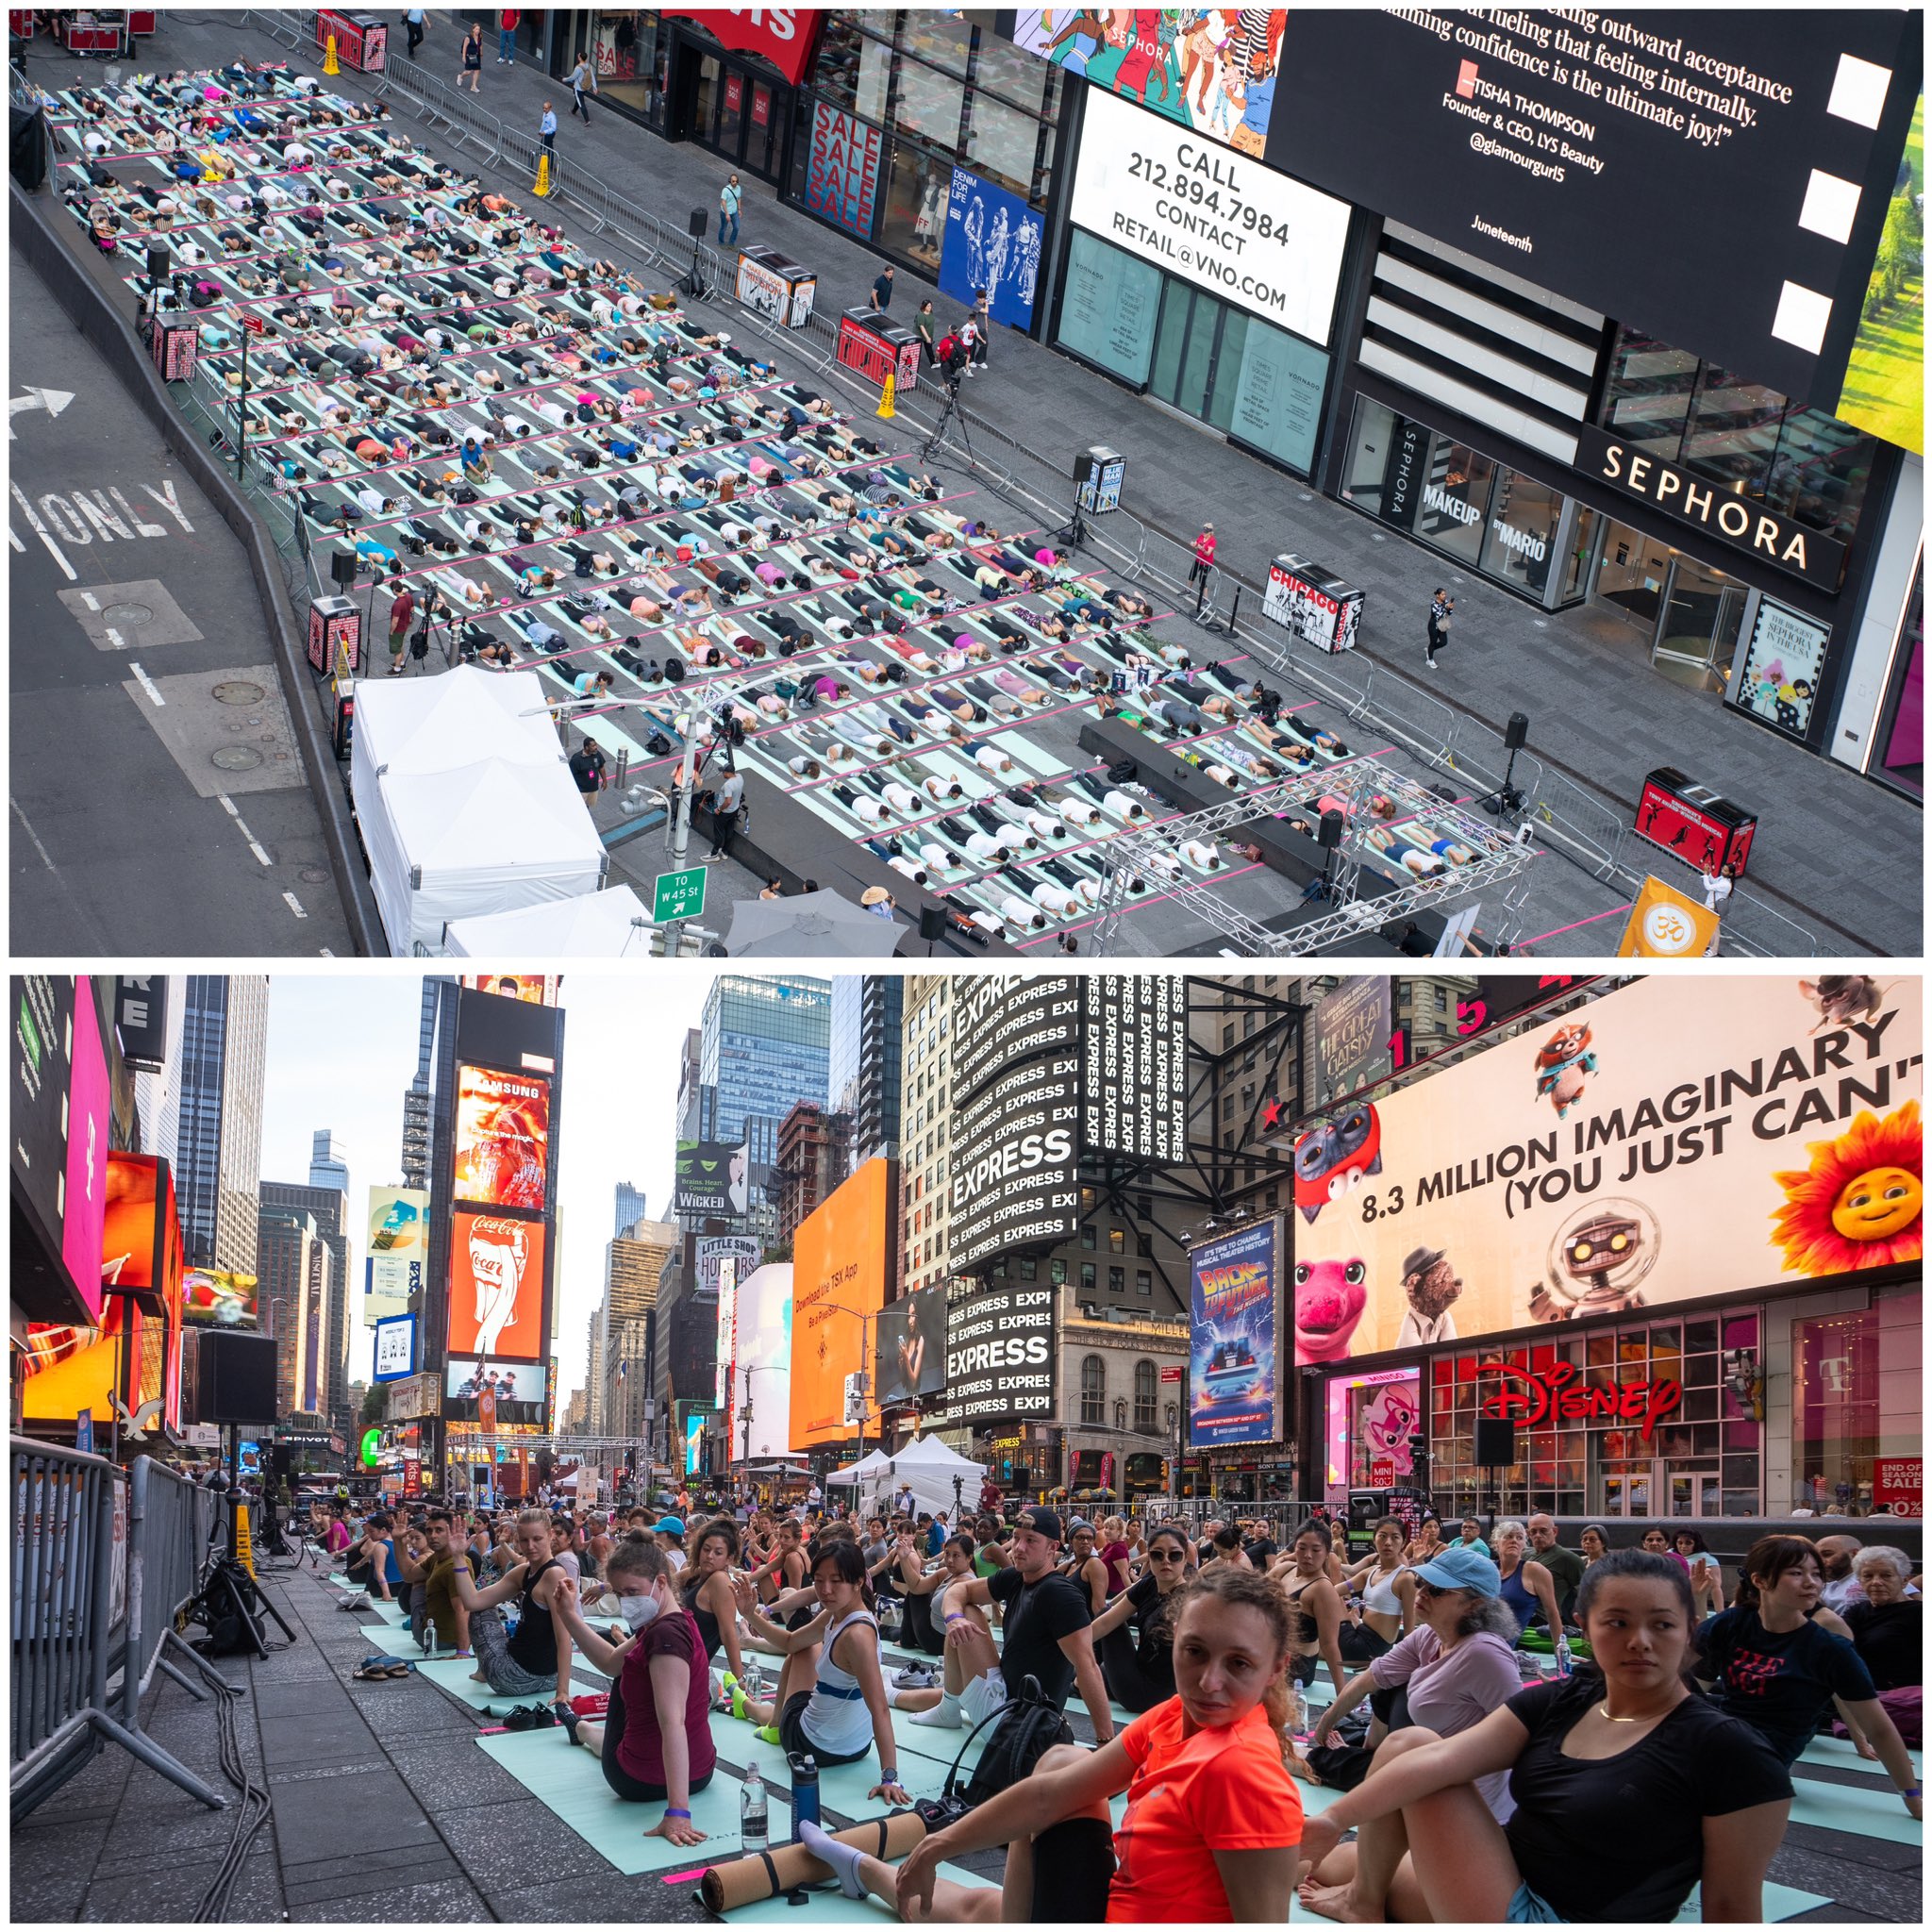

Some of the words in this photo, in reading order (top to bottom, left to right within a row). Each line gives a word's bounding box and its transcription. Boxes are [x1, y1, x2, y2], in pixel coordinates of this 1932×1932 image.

[1111, 26, 1172, 65] SEPHORA
[1489, 8, 1552, 49] fueling
[1555, 28, 1592, 61] that
[1593, 42, 1658, 91] feeling
[1659, 69, 1757, 127] internally.
[1601, 18, 1683, 63] outward
[1684, 50, 1793, 105] acceptance
[1456, 26, 1550, 76] confidence
[1552, 59, 1570, 85] is
[1572, 69, 1603, 98] the
[1606, 84, 1685, 131] ultimate
[816, 103, 880, 158] SALE
[1442, 92, 1492, 125] Founder
[1492, 114, 1505, 131] &
[1507, 119, 1535, 146] CEO,
[1537, 132, 1559, 153] LYS
[1559, 142, 1605, 175] Beauty
[1514, 94, 1596, 142] THOMPSON
[813, 129, 877, 184] SALE
[954, 169, 977, 188] DENIM
[1177, 143, 1241, 192] CALL
[1470, 131, 1566, 183] @glamourgurl5
[810, 156, 875, 210] SALE
[951, 190, 967, 204] LIFE
[952, 178, 968, 193] FOR
[1127, 152, 1290, 247] 212.894.7984
[808, 182, 873, 236] SALE
[1156, 200, 1246, 256] CONTACT
[1471, 214, 1533, 254] Juneteenth
[746, 263, 761, 276] MAKE
[1075, 262, 1104, 280] VORNADO
[1113, 211, 1287, 311] RETAIL@VNO.COM
[1289, 372, 1321, 391] VORNADO
[1104, 473, 1121, 481] MAN
[1391, 430, 1416, 513] SEPHORA
[38, 479, 196, 544] ONLY
[1423, 484, 1481, 526] MAKEUP
[1603, 445, 1807, 571] SEPHORA
[1492, 519, 1503, 531] BY
[1499, 524, 1546, 562] MARIO
[1270, 566, 1339, 615] CHICAGO
[1333, 602, 1349, 651] CHICAGO
[1766, 630, 1774, 642] IN
[1776, 636, 1791, 650] THE
[1791, 643, 1809, 659] USA
[1768, 623, 1812, 651] SEPHORA
[1772, 614, 1784, 625] THE
[1785, 620, 1813, 641] BIGGEST
[1648, 791, 1662, 803] TONY
[1701, 822, 1723, 839] MUSICAL
[1671, 798, 1702, 821] BROADWAY'S
[661, 891, 671, 903] W
[671, 889, 686, 900] 45
[688, 887, 699, 897] St
[675, 875, 688, 887] TO
[973, 1006, 1004, 1043] EXPRESS
[1008, 978, 1067, 1011] EXPRESS
[1322, 1029, 1341, 1062] THE
[1341, 996, 1382, 1043] GREAT
[1387, 1029, 1405, 1069] 1
[1457, 999, 1488, 1035] 5
[963, 1038, 993, 1073] EXPRESS
[995, 1008, 1044, 1042] EXPRESS
[972, 1050, 1003, 1086] EXPRESS
[1008, 1026, 1067, 1057] EXPRESS
[1087, 1024, 1099, 1098] EXPRESS
[1105, 1004, 1117, 1078] EXPRESS
[1141, 1012, 1152, 1086] EXPRESS
[1173, 1020, 1183, 1092] EXPRESS
[1327, 1023, 1376, 1076] GATSBY
[1123, 1031, 1134, 1106] EXPRESS
[1157, 1039, 1168, 1112] EXPRESS
[963, 1092, 992, 1125] EXPRESS
[995, 1066, 1045, 1098] EXPRESS
[971, 1106, 1002, 1140] EXPRESS
[1006, 1084, 1064, 1112] EXPRESS
[1361, 1186, 1406, 1224] 8.3
[1416, 1130, 1557, 1208] MILLION
[1574, 1008, 1900, 1156] IMAGINARY
[511, 1133, 535, 1143] magic.
[962, 1136, 992, 1166] EXPRESS
[994, 1112, 1045, 1142] EXPRESS
[954, 1128, 1072, 1208] EXPRESS
[1504, 1156, 1602, 1220] (YOU
[1618, 1117, 1732, 1183] JUST
[969, 1188, 1000, 1217] EXPRESS
[1005, 1170, 1064, 1195] EXPRESS
[961, 1216, 991, 1242] EXPRESS
[993, 1197, 1044, 1224] EXPRESS
[968, 1234, 1000, 1260] EXPRESS
[1004, 1219, 1064, 1242] EXPRESS
[702, 1239, 733, 1256] LITTLE
[734, 1239, 757, 1256] SHOP
[1196, 1257, 1219, 1268] MUSICAL
[1220, 1247, 1244, 1259] THEATER
[1245, 1237, 1271, 1251] HISTORY
[1205, 1249, 1214, 1257] IT'S
[1215, 1245, 1227, 1255] TIME
[1237, 1232, 1260, 1247] CHANGE
[795, 1290, 821, 1313] Download
[821, 1281, 831, 1295] the
[831, 1270, 843, 1290] TSX
[844, 1262, 858, 1283] App
[1197, 1261, 1268, 1296] BACK
[1205, 1295, 1217, 1308] TO
[1217, 1275, 1270, 1314] FUTURE
[958, 1320, 993, 1341] EXPRESS
[967, 1295, 1009, 1318] EXPRESS
[947, 1336, 1048, 1379] EXPRESS
[1369, 1369, 1406, 1383] MINISO
[1819, 1357, 1850, 1391] T
[427, 1375, 438, 1415] HELLO!
[958, 1379, 992, 1397] EXPRESS
[965, 1398, 1008, 1415] EXPRESS
[1474, 1360, 1683, 1442] Disney
[995, 1437, 1021, 1448] EXPRESS
[408, 1461, 419, 1481] tkts
[1374, 1467, 1392, 1475] MINI
[1882, 1477, 1923, 1489] SALE
[1907, 1463, 1923, 1472] OF
